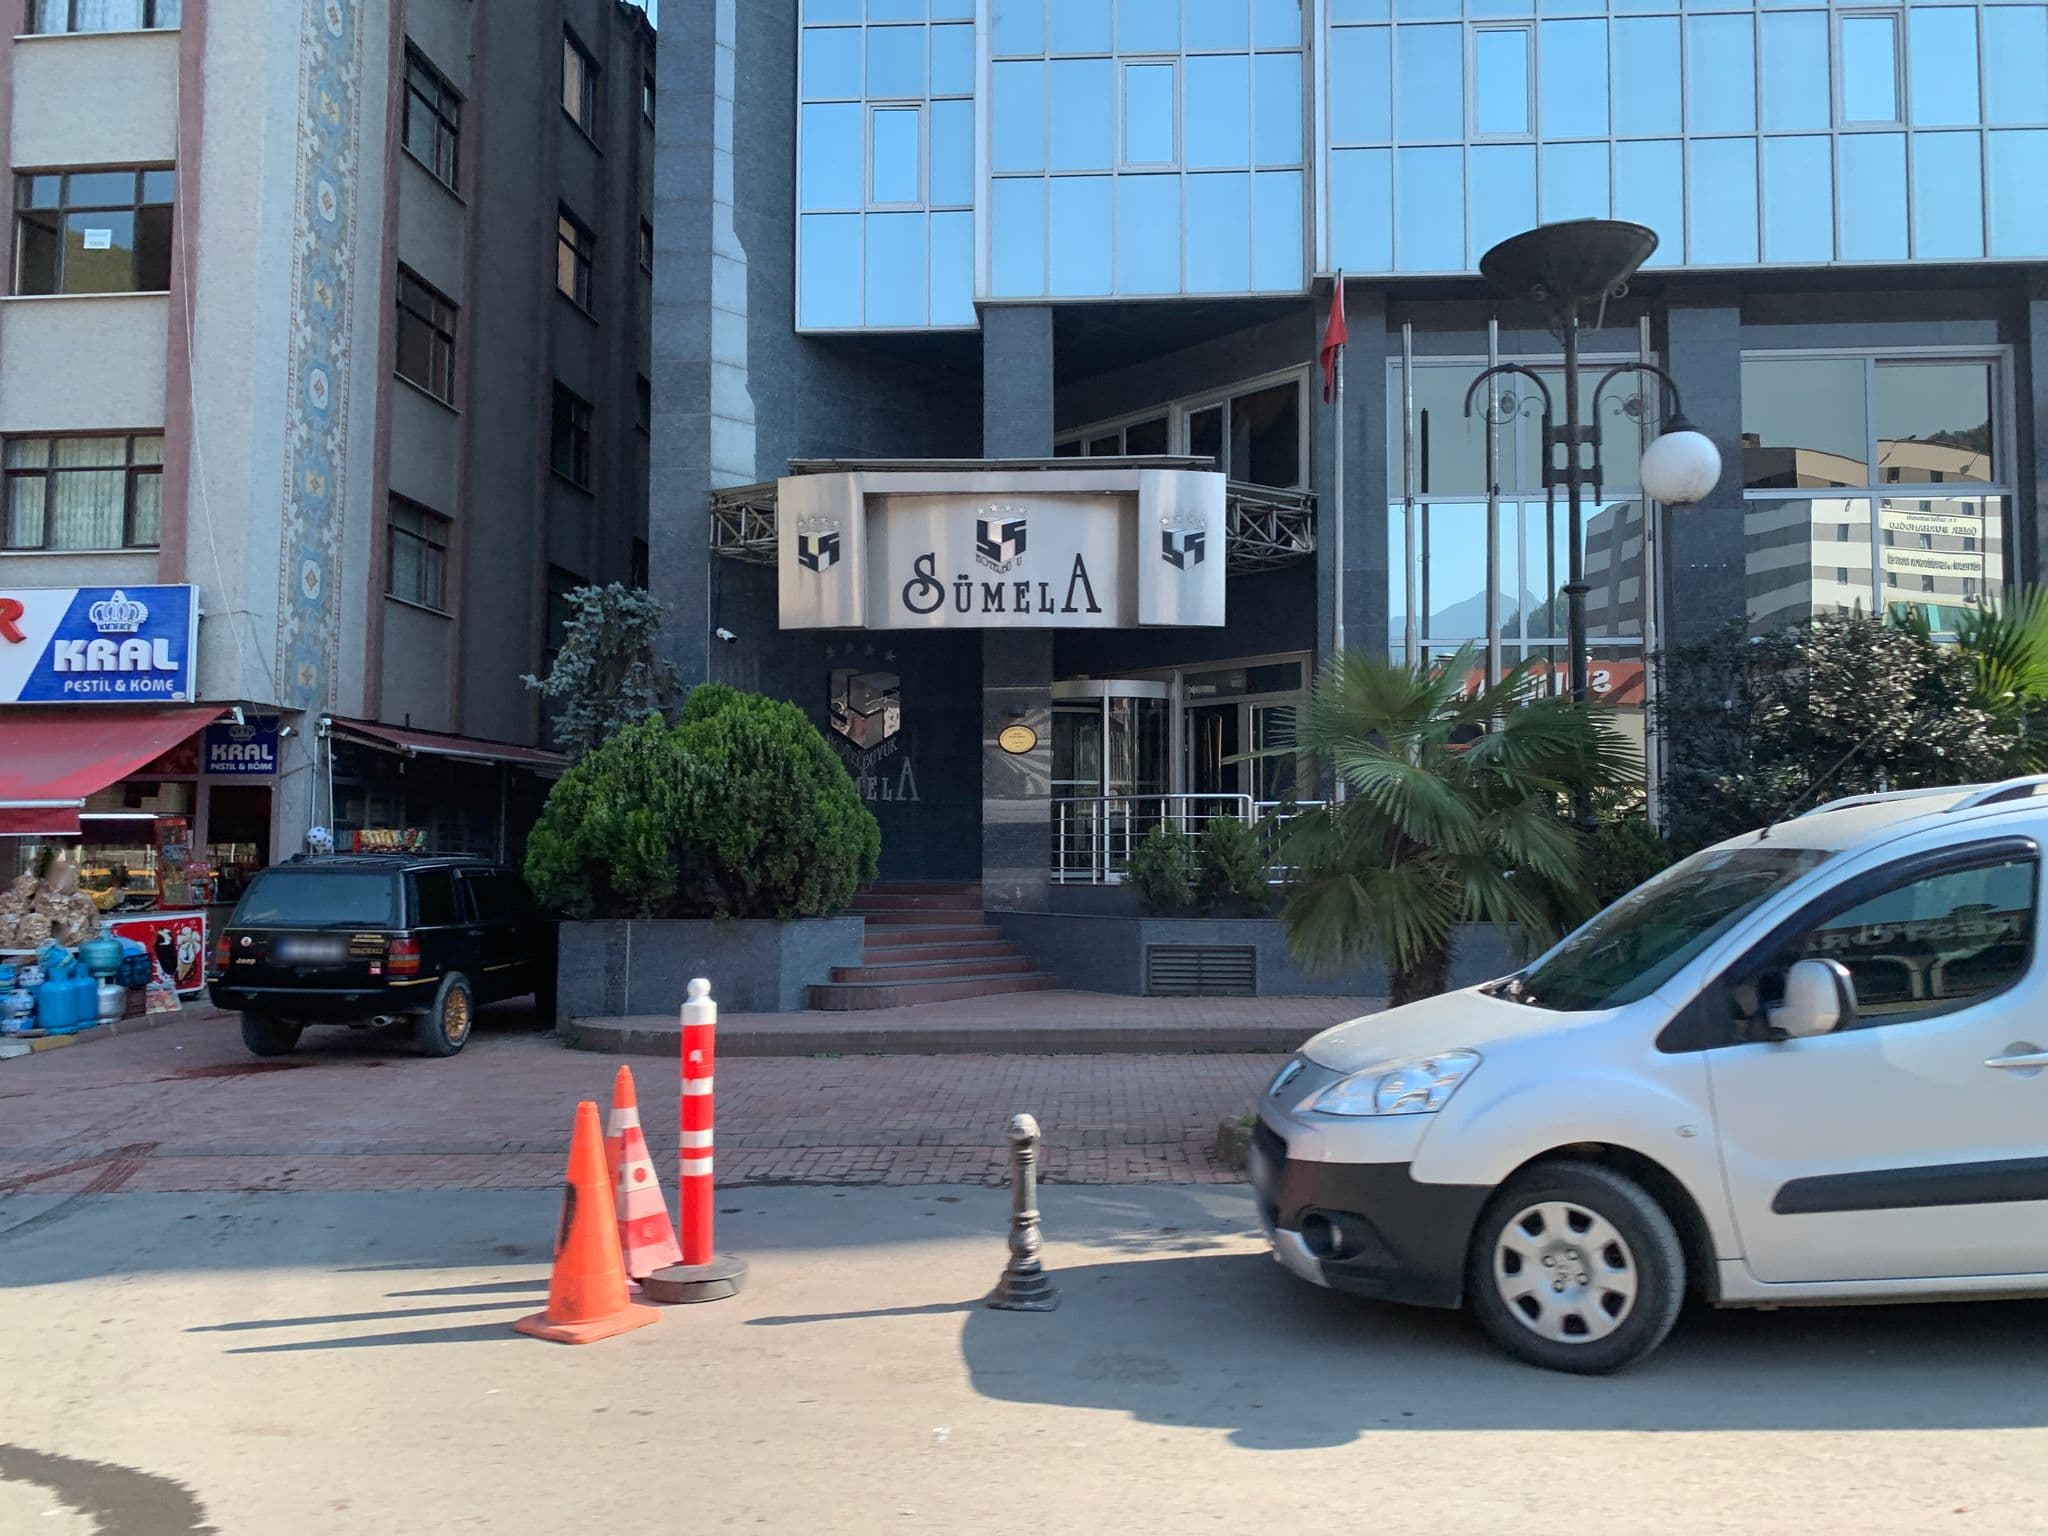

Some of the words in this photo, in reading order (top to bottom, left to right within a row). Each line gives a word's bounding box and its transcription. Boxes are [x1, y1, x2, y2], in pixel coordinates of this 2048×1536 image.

[902, 552, 1101, 614] SÜMELA
[53, 638, 179, 672] KRAL
[64, 676, 111, 693] PESTİL
[115, 679, 126, 693] &
[129, 676, 174, 693] KÖME
[211, 743, 274, 761] KRAL
[247, 761, 273, 771] KÖME
